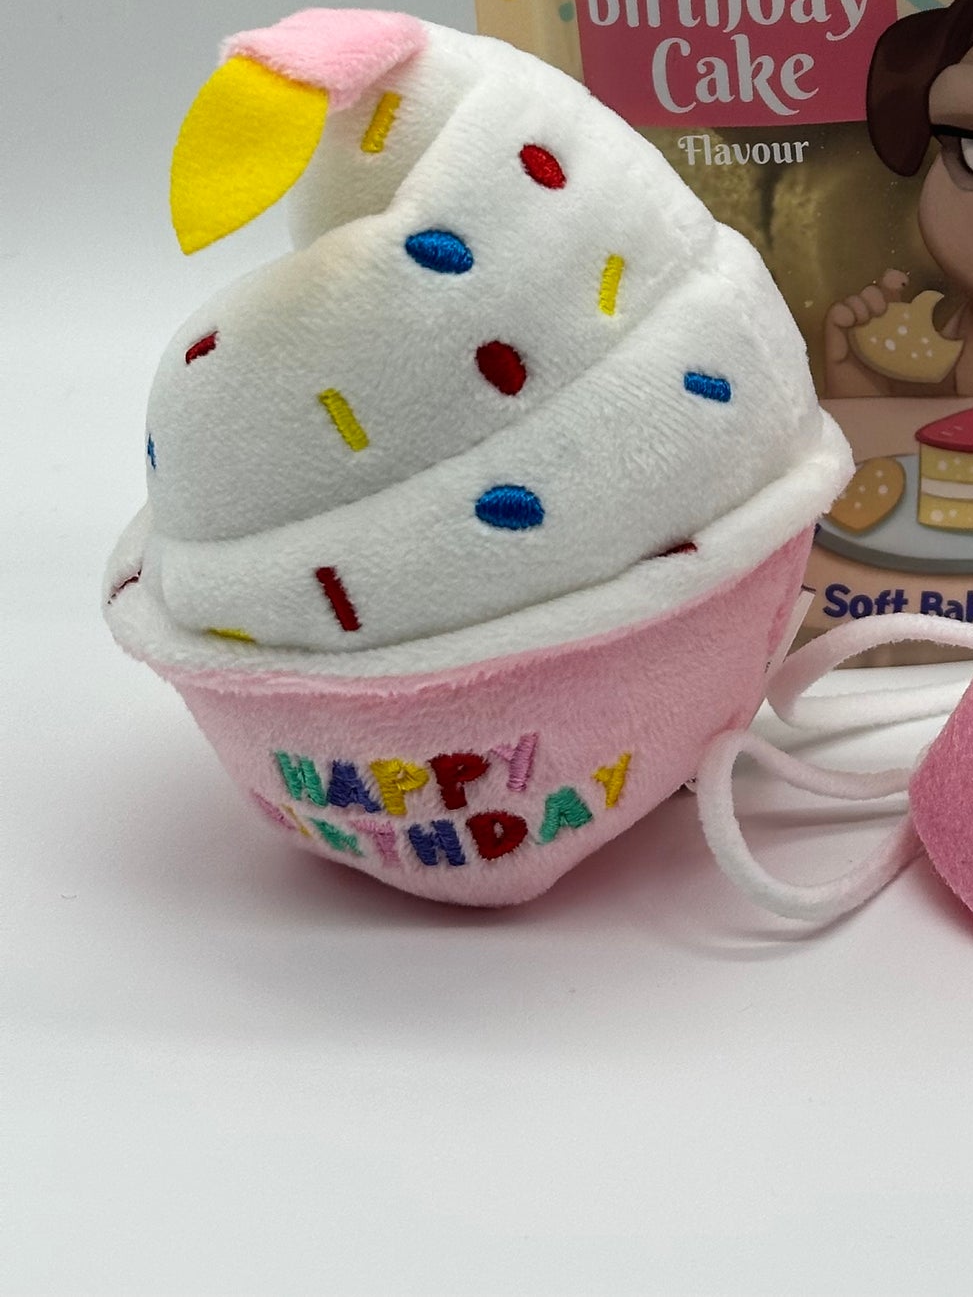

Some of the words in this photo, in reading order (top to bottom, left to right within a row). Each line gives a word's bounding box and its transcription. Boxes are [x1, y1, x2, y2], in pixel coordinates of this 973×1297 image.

[651, 33, 820, 117] Cake
[677, 133, 810, 167] Flavour
[822, 583, 909, 620] Soft
[271, 732, 539, 816] HAPPY
